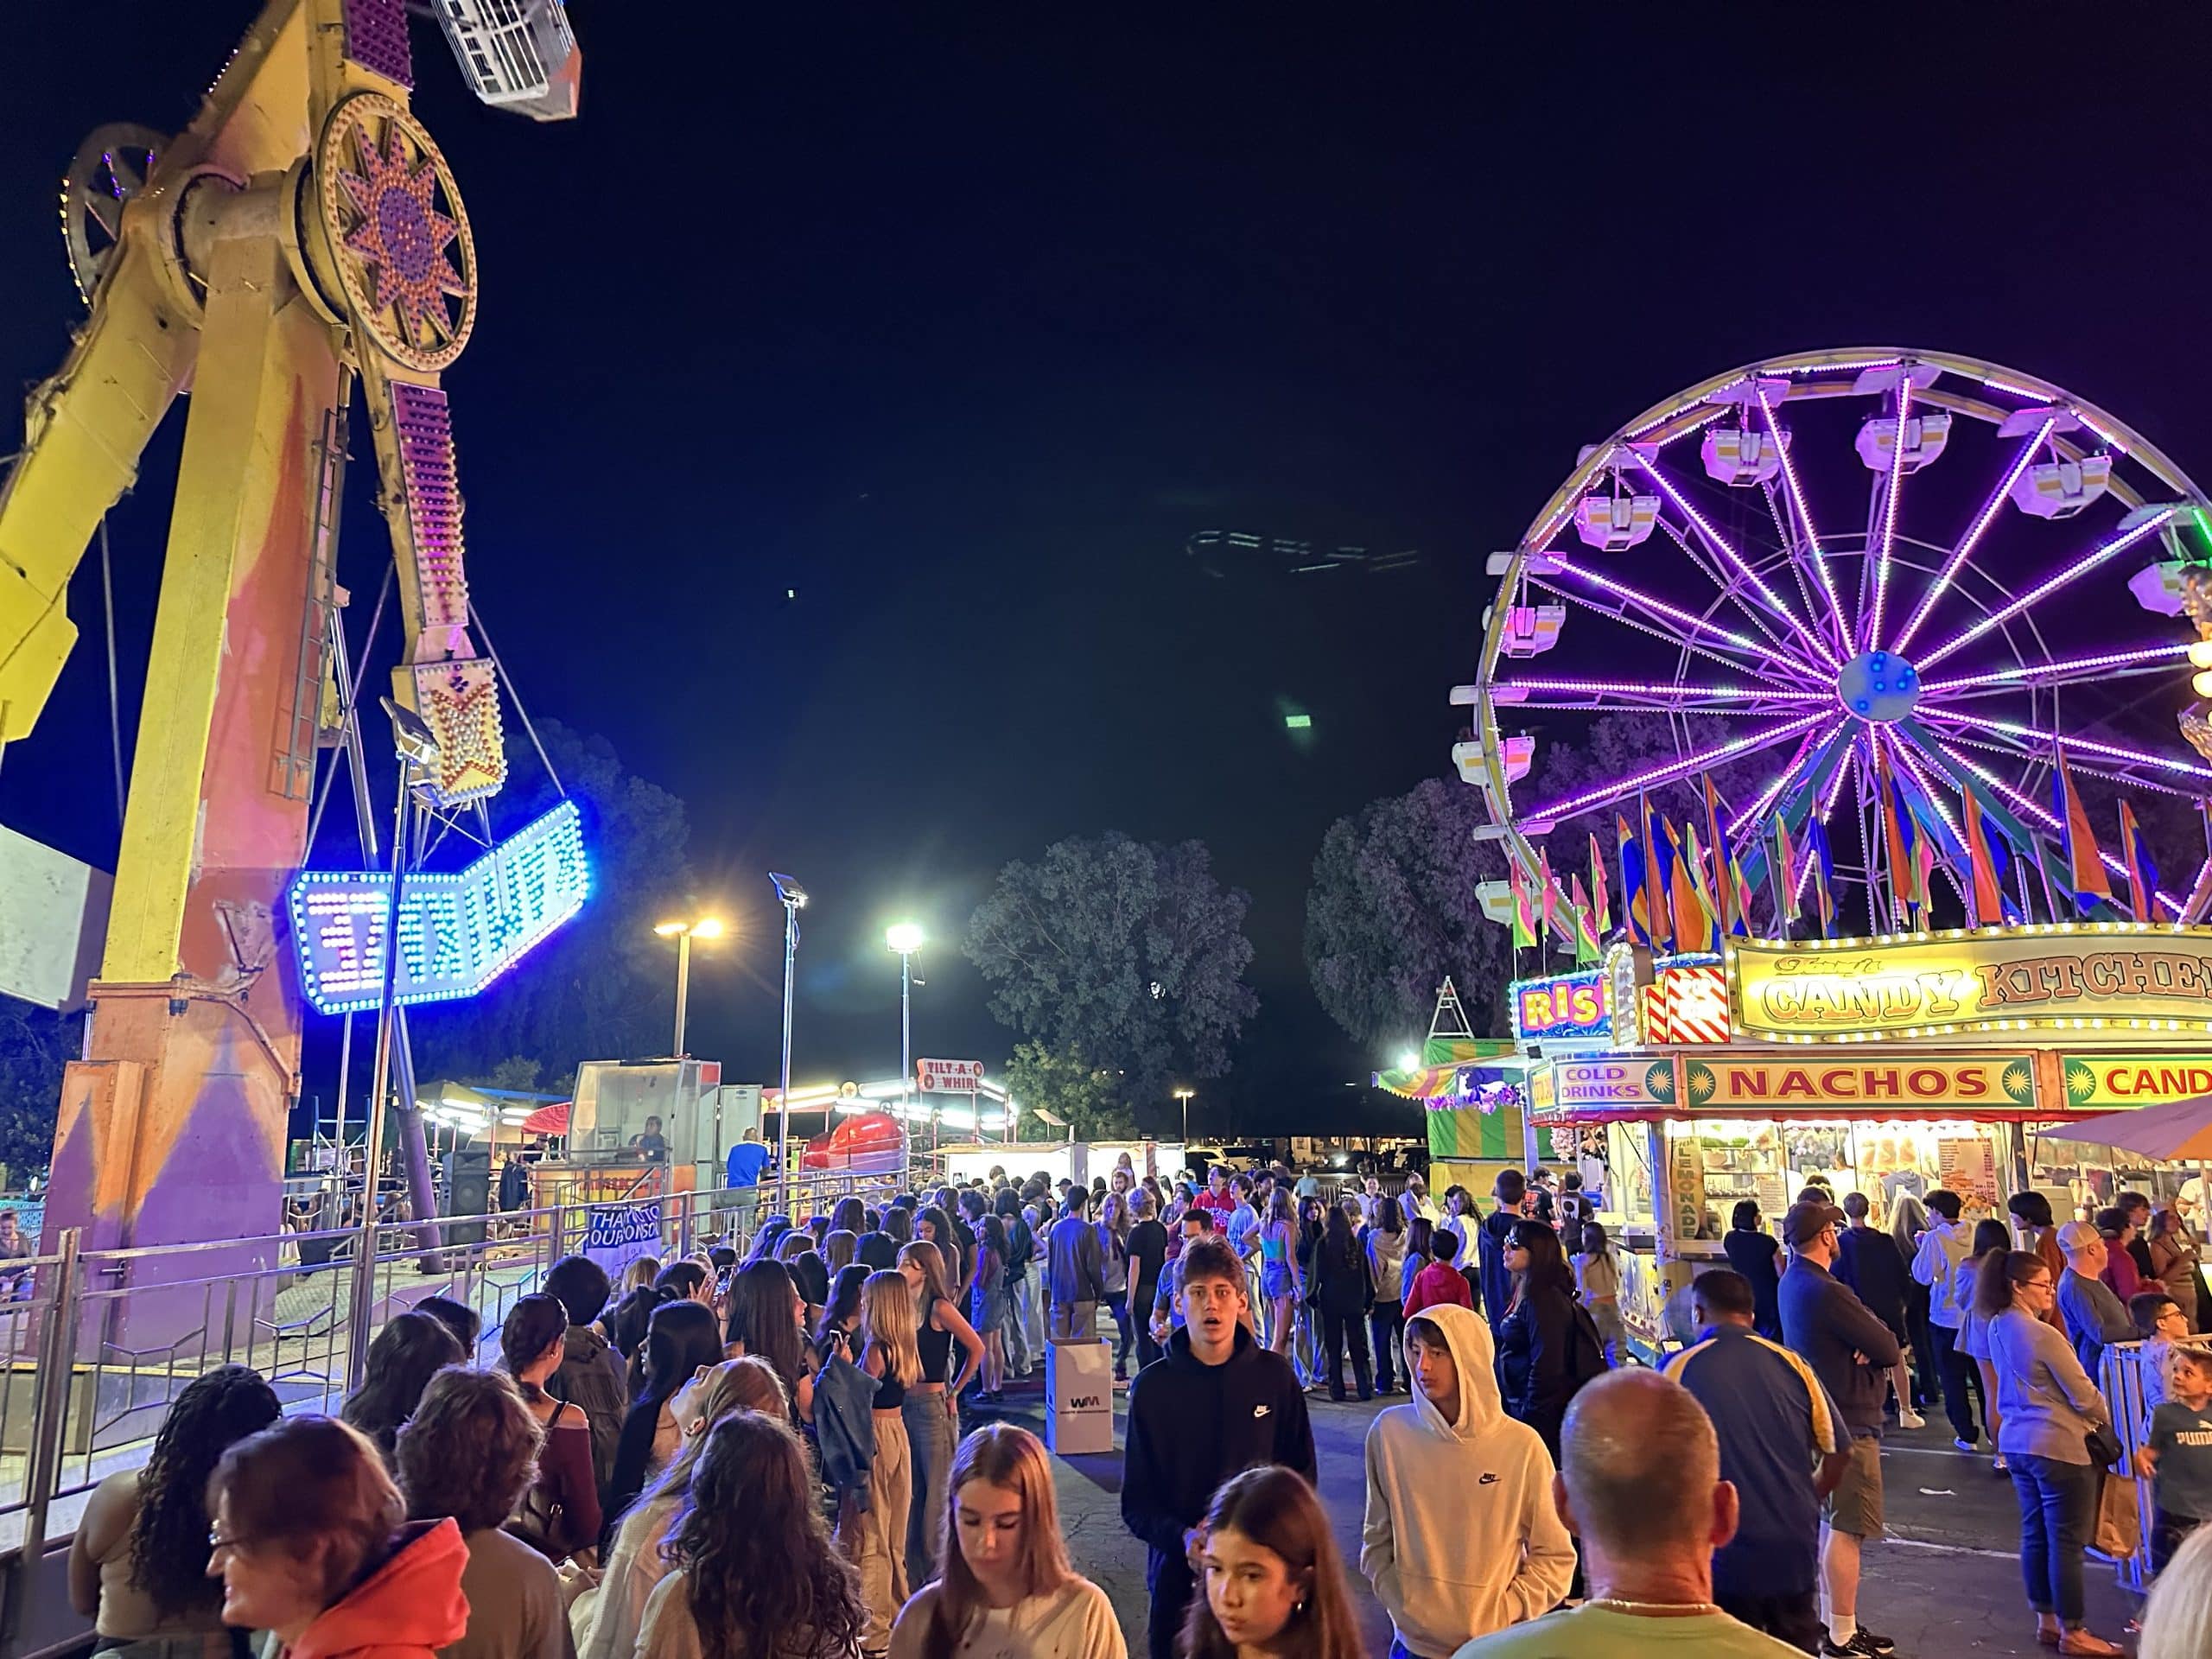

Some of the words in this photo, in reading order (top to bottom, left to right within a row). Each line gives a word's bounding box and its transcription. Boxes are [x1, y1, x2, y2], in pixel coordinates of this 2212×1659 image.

[1764, 969, 1964, 1020] CANDY
[1975, 951, 2212, 1007] KITCHE
[1566, 1067, 1625, 1081] COLD
[943, 1077, 981, 1089] WHIRL
[1730, 1070, 1987, 1096] NACHOS
[1562, 1084, 1641, 1097] DRINKS
[1677, 1147, 1697, 1239] LEMONADE
[1071, 1395, 1100, 1408] WM
